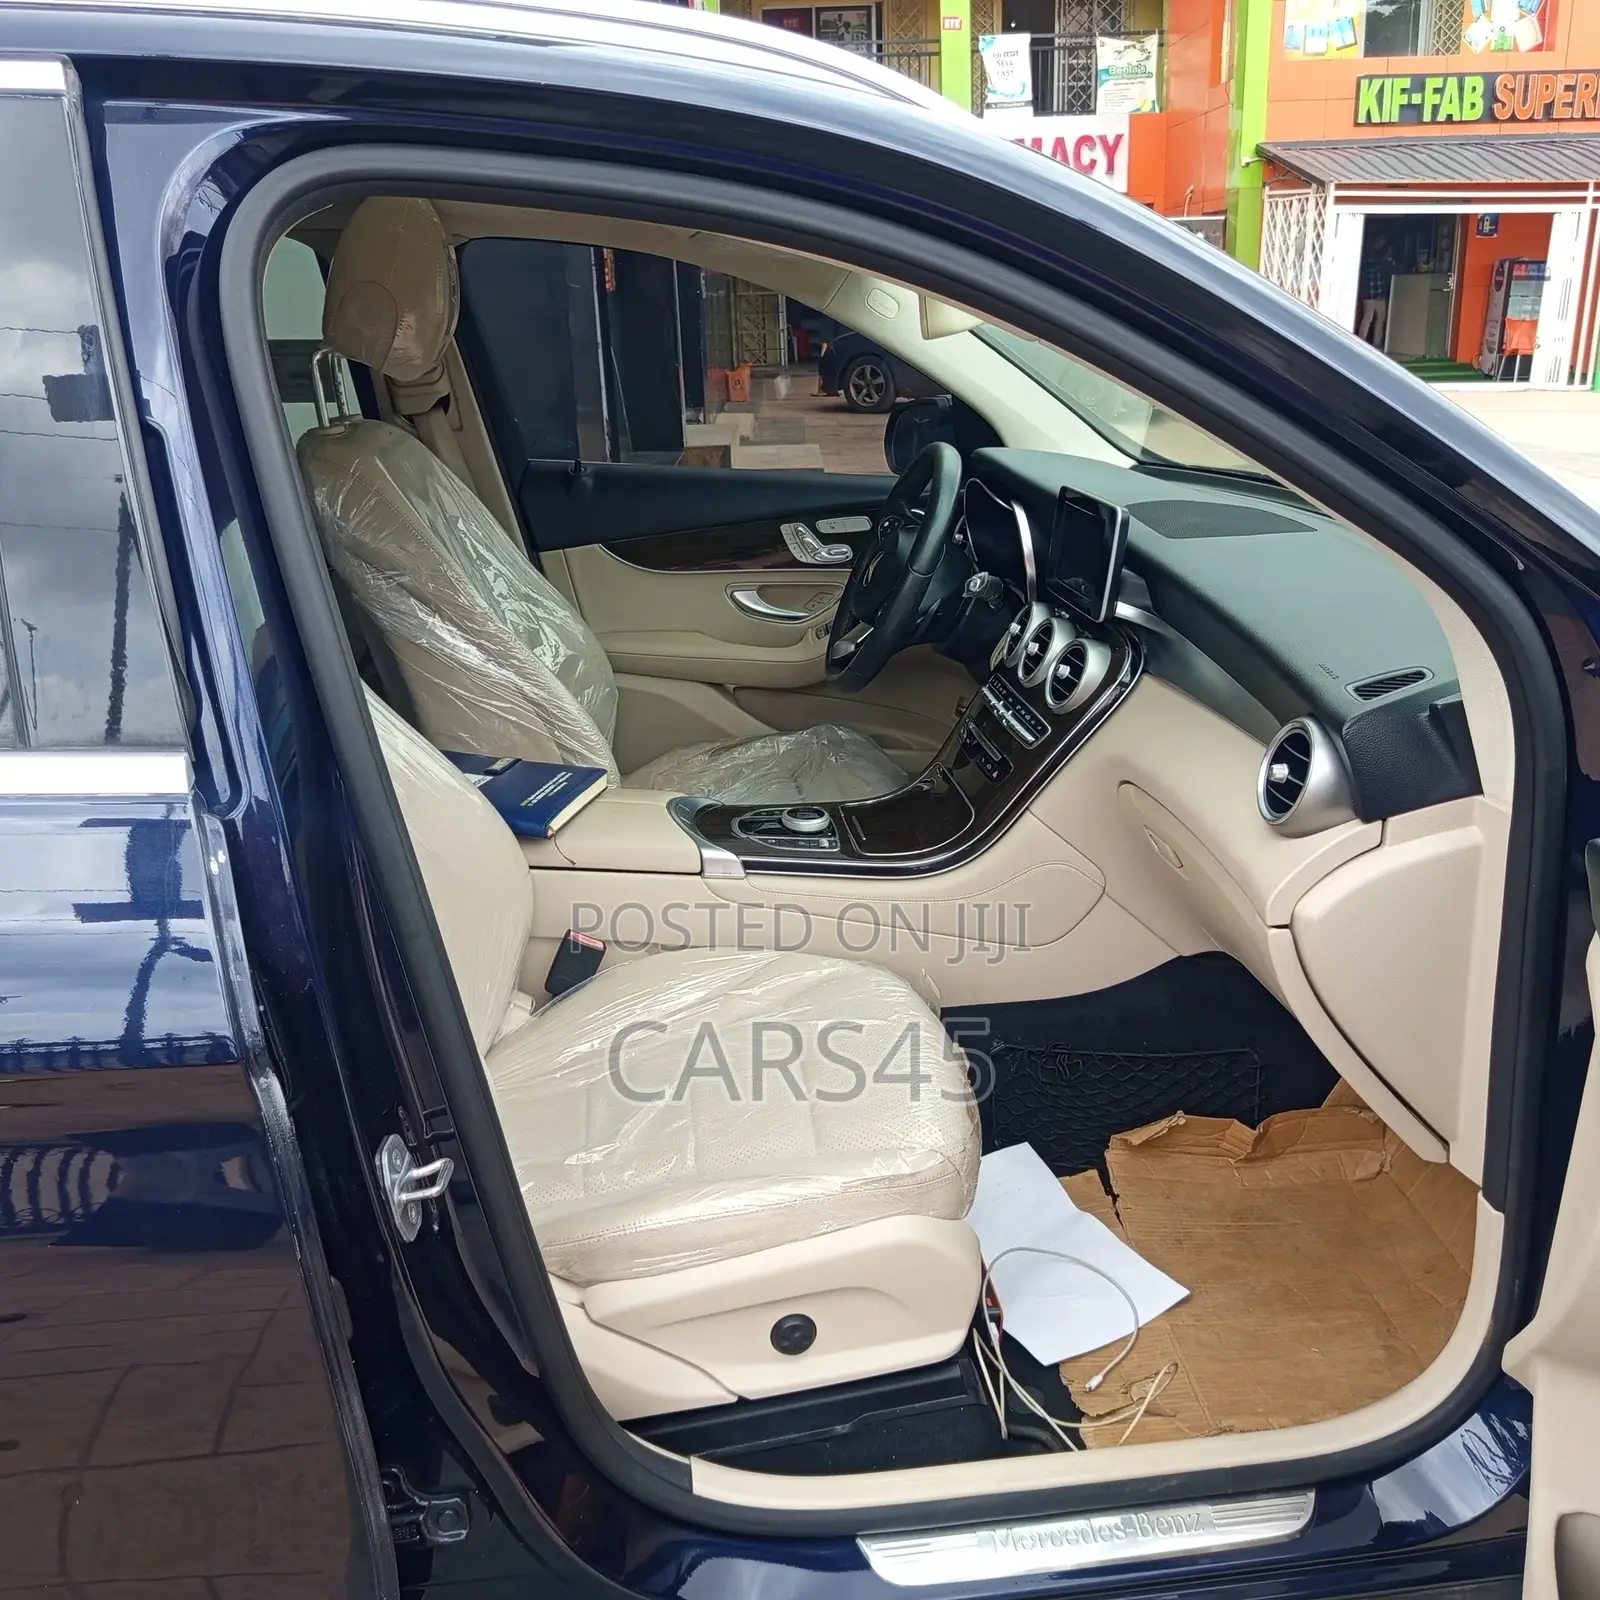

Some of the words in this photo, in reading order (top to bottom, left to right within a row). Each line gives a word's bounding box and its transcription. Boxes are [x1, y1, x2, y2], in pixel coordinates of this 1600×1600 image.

[1357, 76, 1485, 123] KIF-FAB
[1492, 73, 1600, 120] SUPER
[991, 1512, 1204, 1554] Mercedes-Benz
